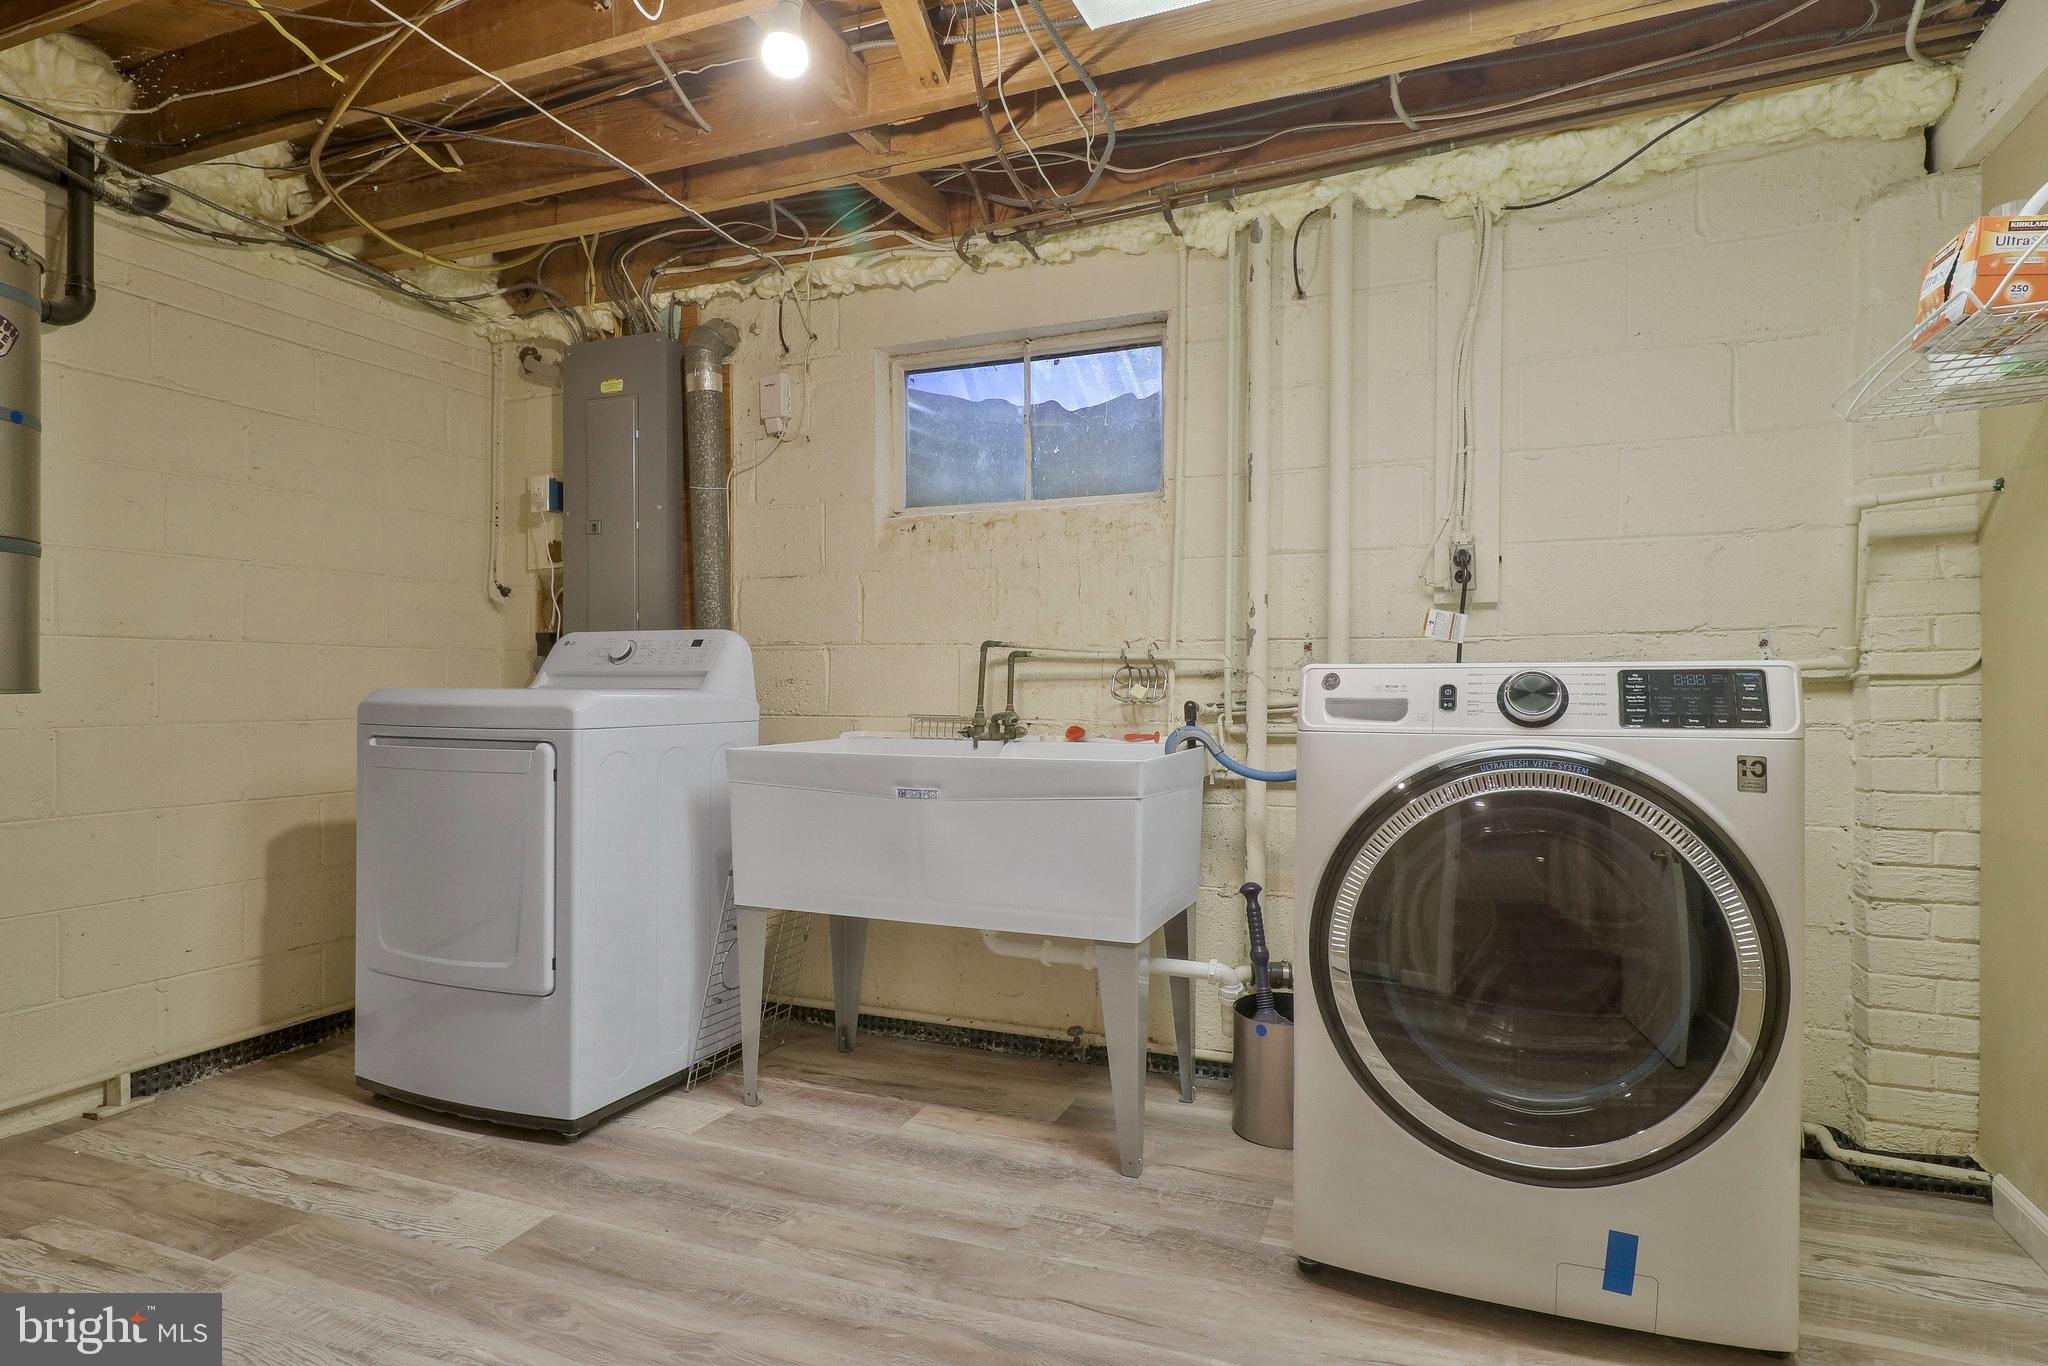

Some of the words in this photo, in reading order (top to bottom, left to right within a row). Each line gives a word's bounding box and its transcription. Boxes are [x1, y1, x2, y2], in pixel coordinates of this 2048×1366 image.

[2011, 285, 2029, 293] 250
[1479, 760, 1528, 772] ULTRAFRESH
[1533, 760, 1553, 768] VENT
[1558, 763, 1590, 775] SYSTEM
[1738, 759, 1767, 778] 10
